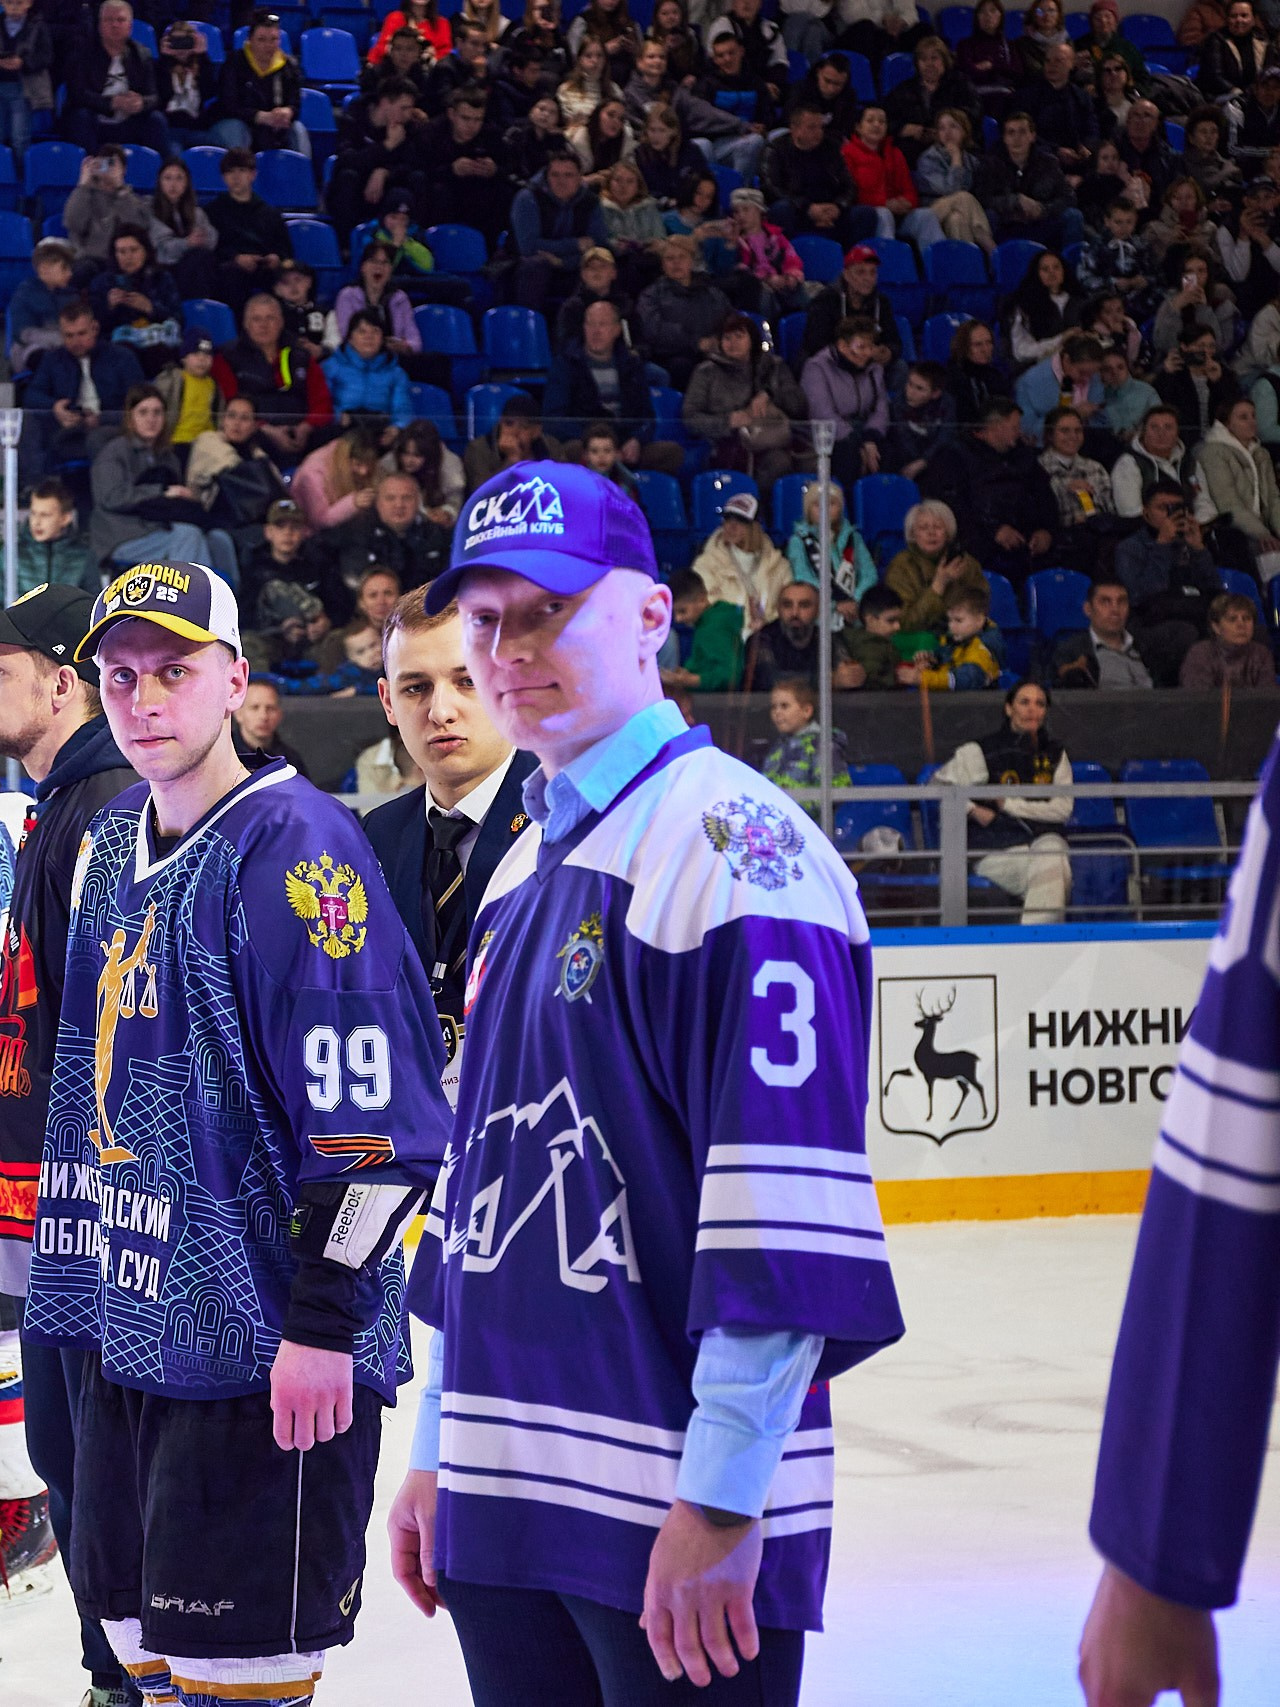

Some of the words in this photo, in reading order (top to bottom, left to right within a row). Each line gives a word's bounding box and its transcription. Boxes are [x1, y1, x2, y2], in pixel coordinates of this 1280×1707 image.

[464, 520, 527, 550] ХОККЕЙНЫЙ
[529, 521, 565, 534] КЛУБ
[155, 585, 179, 603] 25
[750, 960, 817, 1088] 3
[304, 1024, 392, 1112] 99
[330, 1188, 364, 1246] Reebok
[117, 1249, 160, 1301] СУД
[150, 1592, 235, 1617] GRAF
